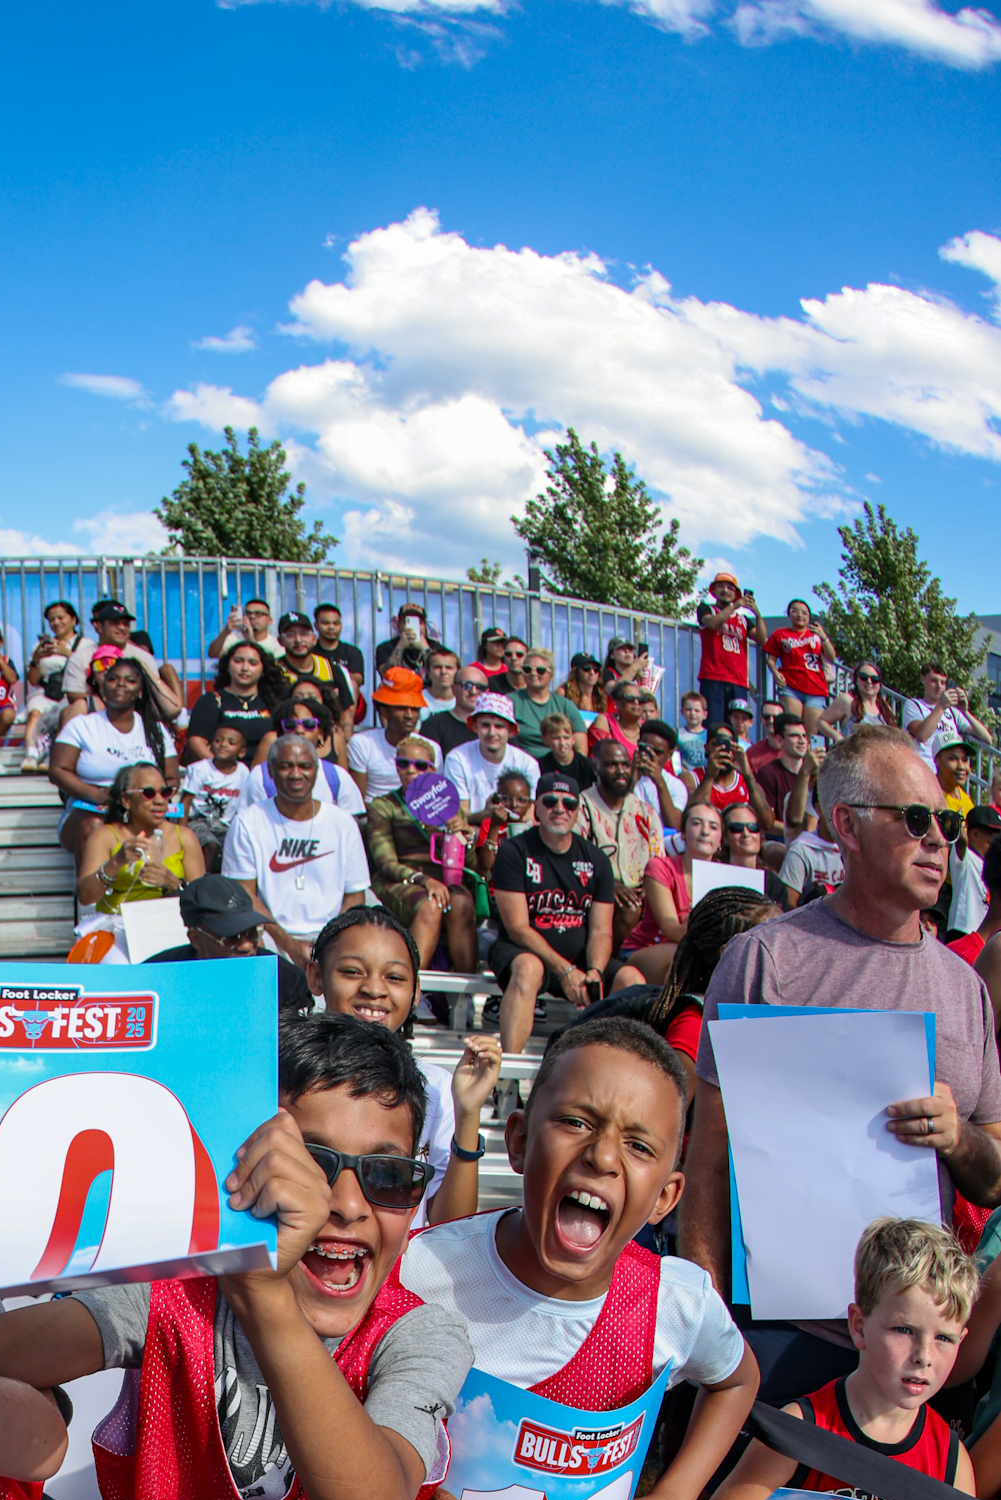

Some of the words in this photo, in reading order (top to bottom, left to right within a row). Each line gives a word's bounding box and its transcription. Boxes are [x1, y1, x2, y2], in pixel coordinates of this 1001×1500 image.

[722, 635, 740, 654] 91
[419, 780, 448, 805] wayfair
[279, 838, 320, 857] NIKE
[2, 988, 29, 999] Foot
[33, 989, 76, 1000] Locker
[51, 1007, 121, 1038] FEST
[127, 1007, 145, 1022] 20
[125, 1022, 145, 1038] 25
[576, 1431, 595, 1440] Foot
[597, 1429, 620, 1440] Locker
[520, 1431, 583, 1468] BULLS
[602, 1431, 634, 1466] FEST
